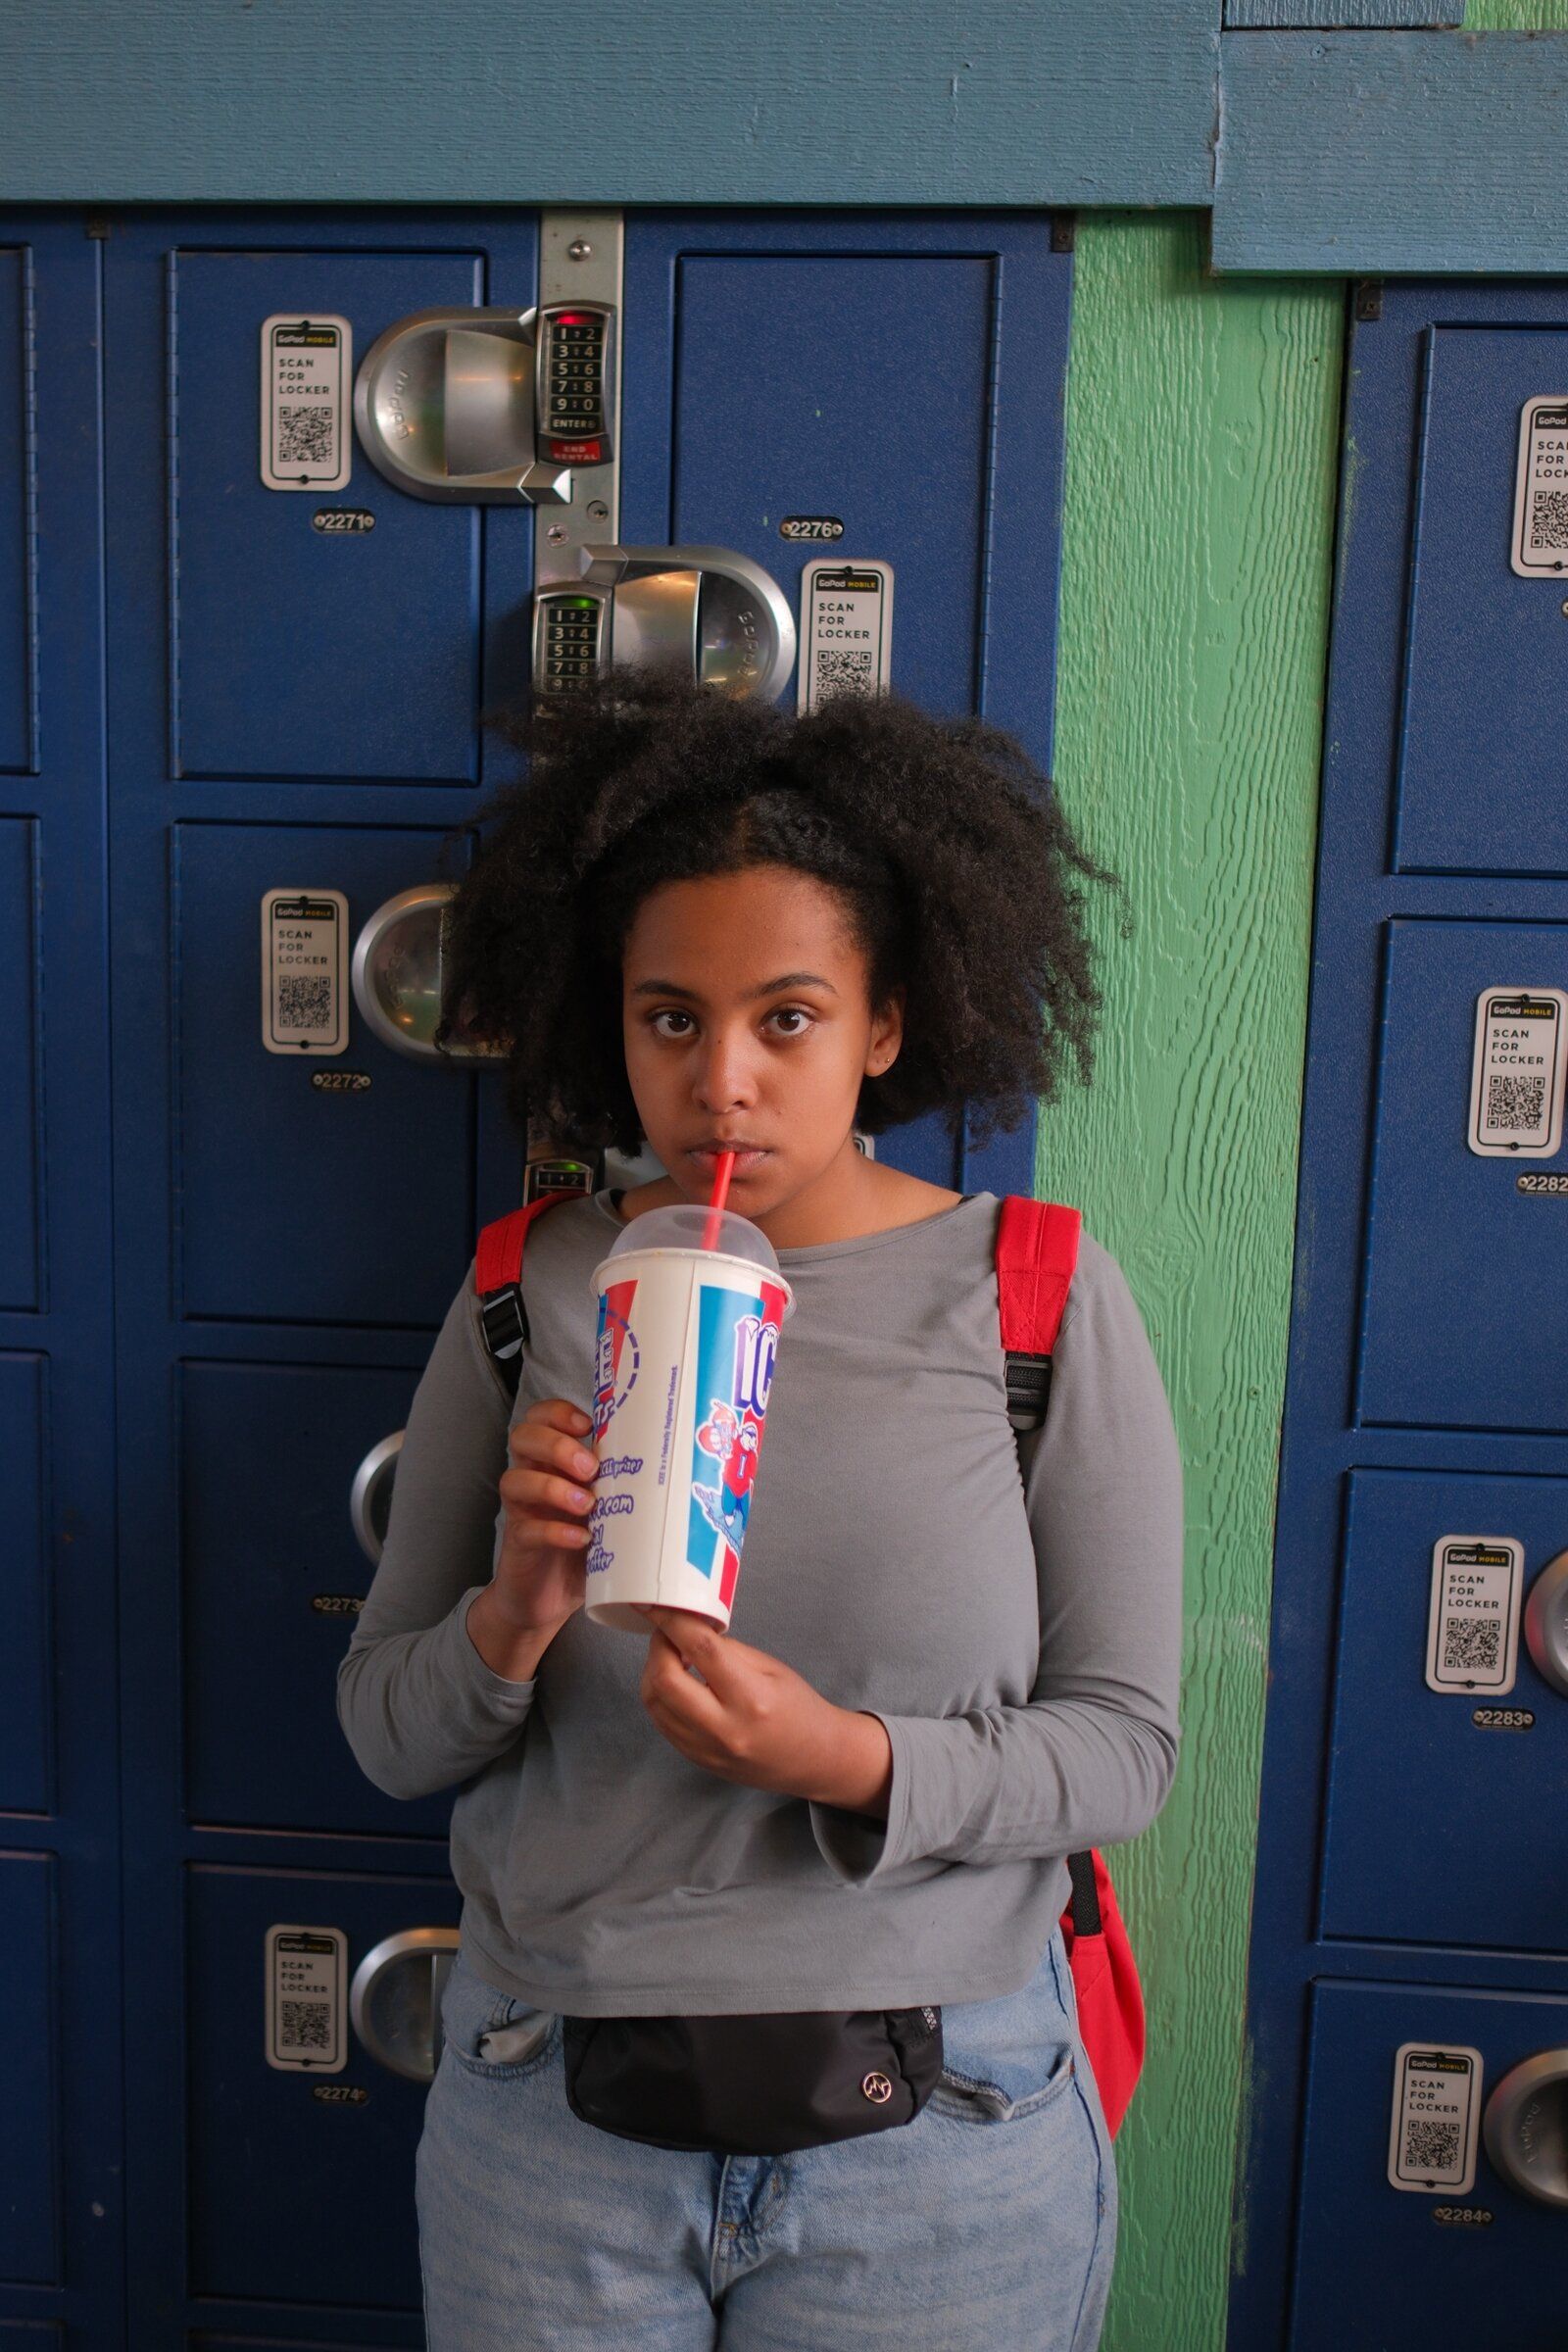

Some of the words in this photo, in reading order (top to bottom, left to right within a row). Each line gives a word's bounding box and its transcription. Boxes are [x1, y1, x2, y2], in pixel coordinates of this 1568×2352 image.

[278, 359, 314, 368] SCAN
[278, 385, 329, 394] LOCKER
[553, 418, 588, 428] ENTER
[1539, 416, 1567, 425] GoPod
[1538, 441, 1568, 451] SCA
[1537, 455, 1564, 465] FOR
[324, 514, 365, 529] 2271
[790, 521, 833, 537] 2276
[818, 578, 846, 588] GoPod
[818, 602, 855, 612] SCAN
[817, 615, 845, 625] FOR
[817, 629, 870, 639] LOCKER
[276, 908, 304, 917] GoPod
[278, 930, 313, 939] SCAN
[278, 943, 304, 952] FOR
[1494, 1005, 1521, 1015] GoPod
[1493, 1029, 1530, 1039] SCAN
[1491, 1055, 1544, 1064] LOCKER
[321, 1074, 363, 1088] 2272
[1527, 1175, 1568, 1192] 2282
[613, 1454, 643, 1479] prizes
[1450, 1553, 1477, 1562] GoPod
[1449, 1575, 1486, 1584] SCAN
[1448, 1587, 1474, 1595] FOR
[321, 1597, 361, 1612] 2273
[1448, 1599, 1499, 1609] LOCKER
[1482, 1711, 1524, 1727] 2283
[281, 1961, 314, 1970] SCAN
[281, 1972, 306, 1982] FOR
[281, 1984, 327, 1993] LOCKER
[1411, 2060, 1437, 2069] GoPod
[1439, 2062, 1466, 2071] MOBILE
[1411, 2080, 1445, 2089] SCAN
[321, 2087, 361, 2101] 2274
[1410, 2091, 1435, 2101] FOR
[1409, 2103, 1459, 2113] LOCKER
[1443, 2207, 1484, 2223] 2284
